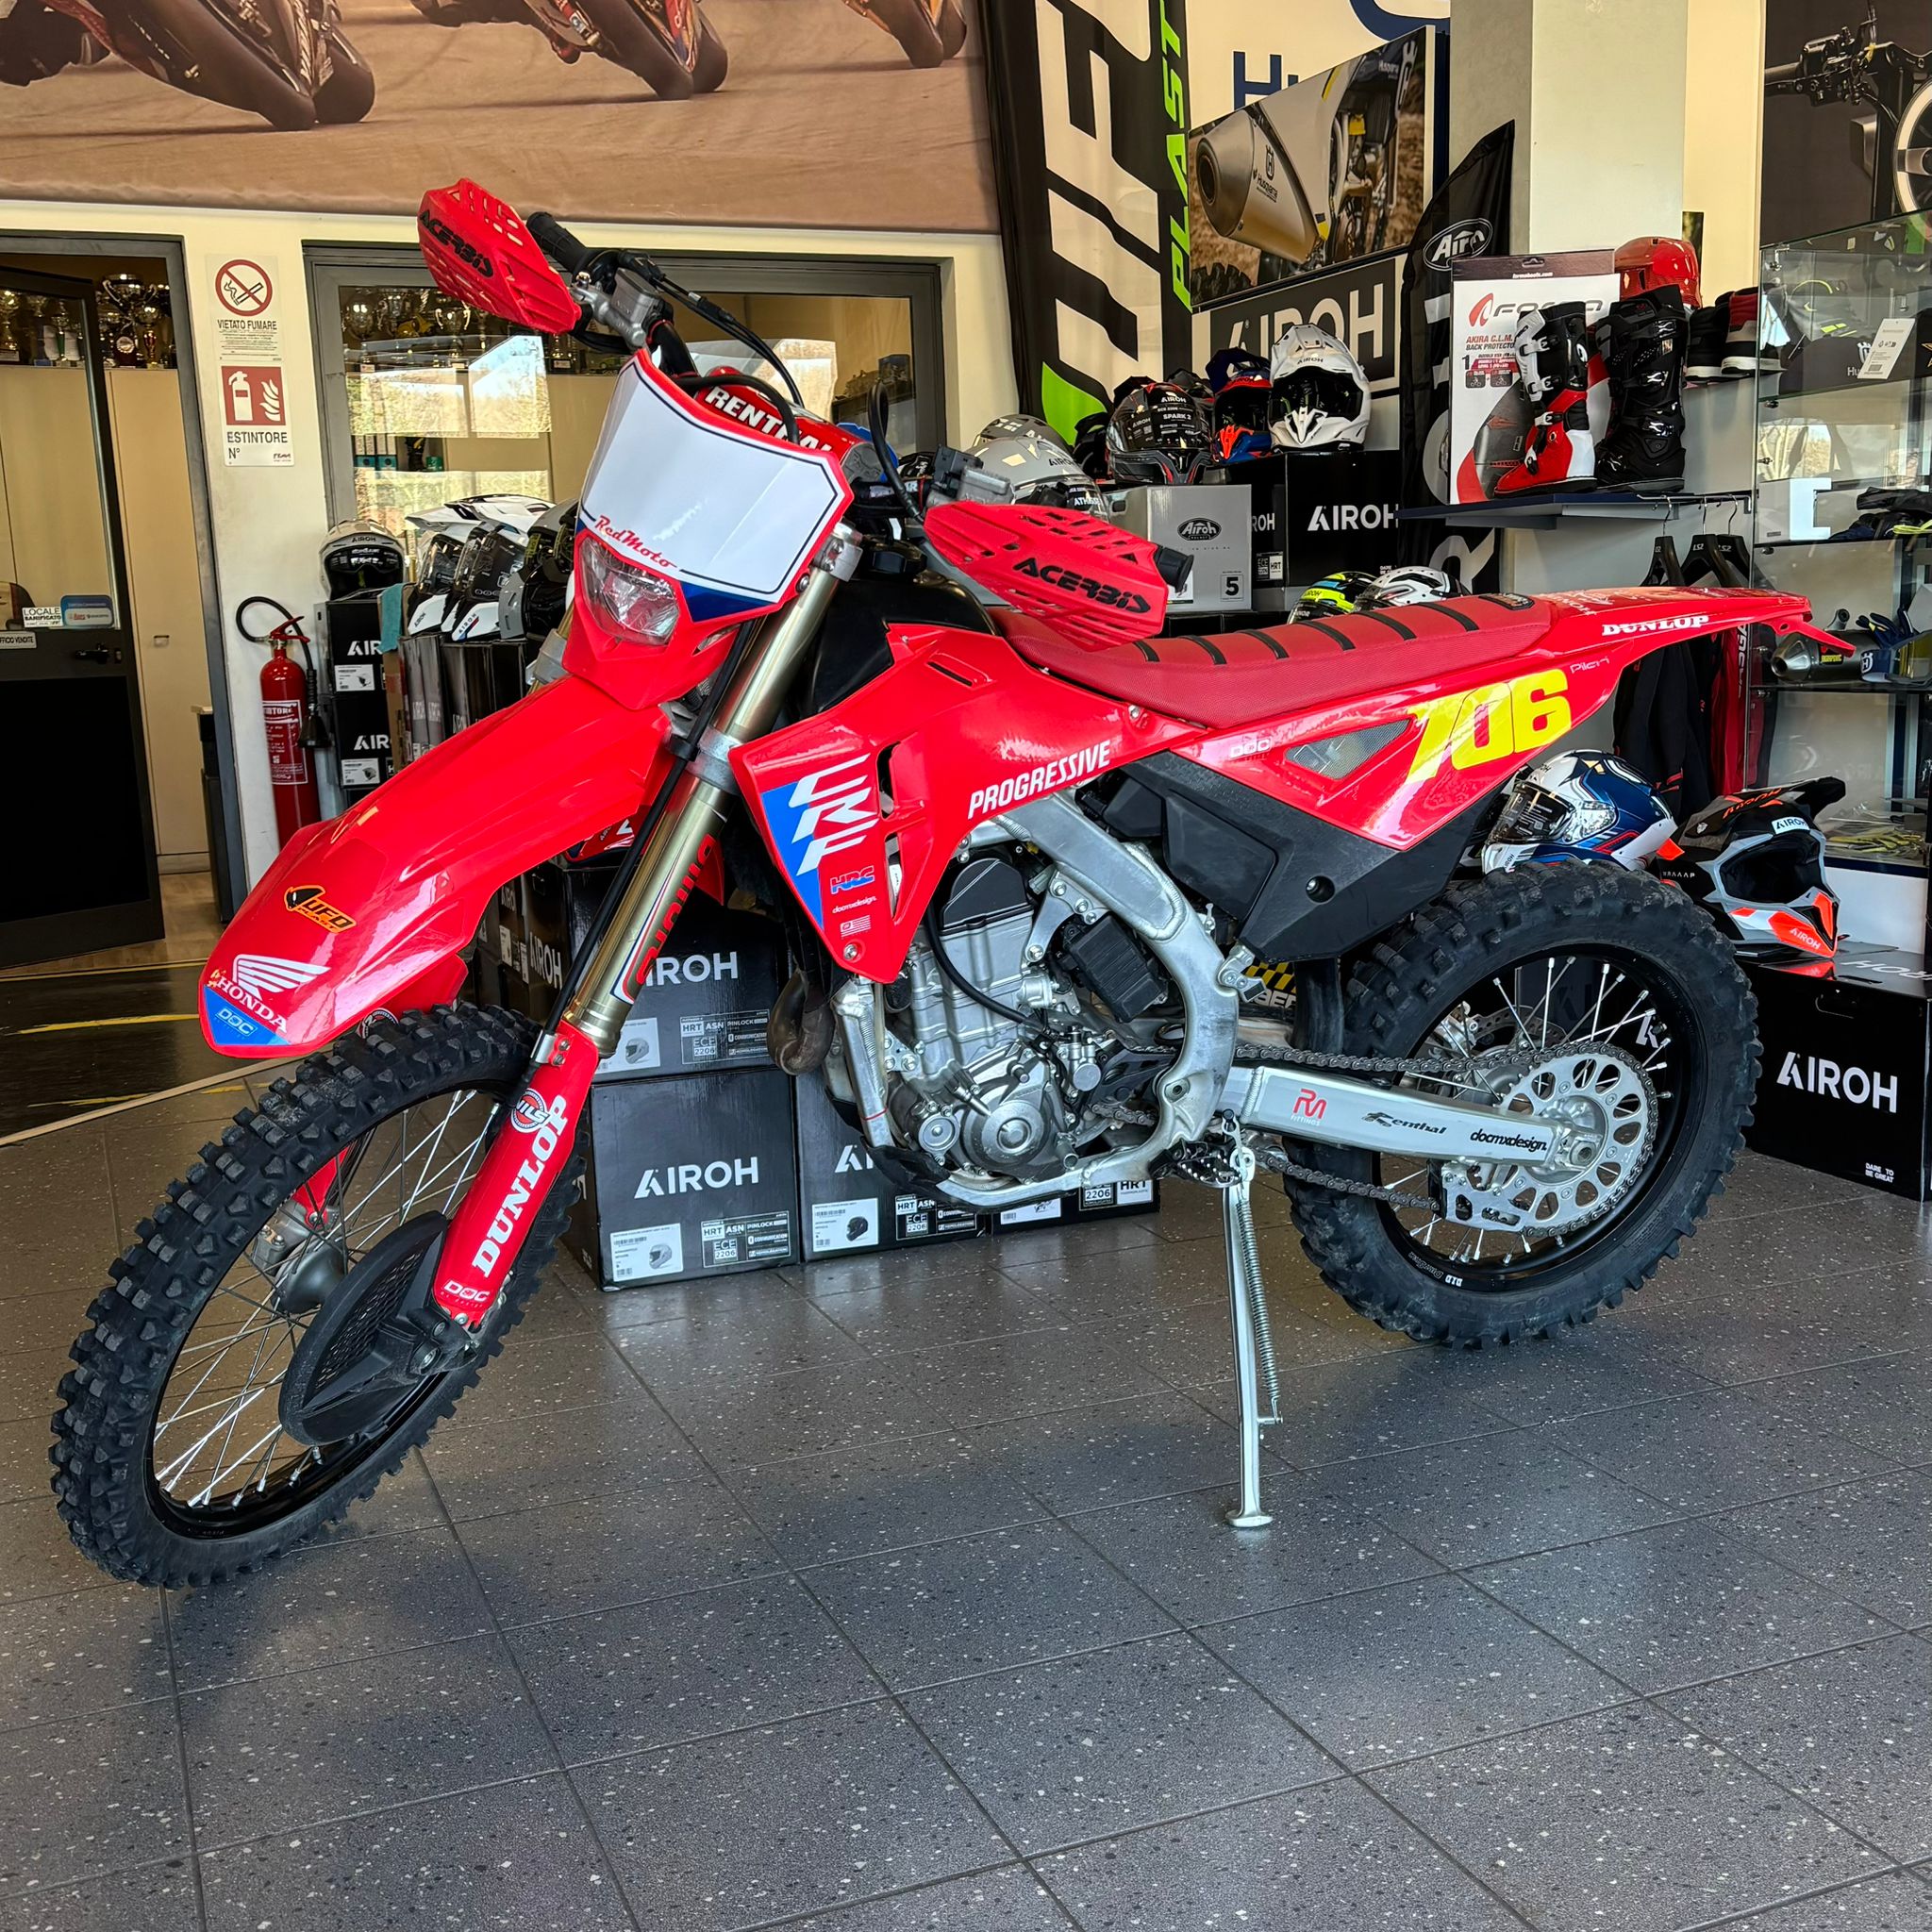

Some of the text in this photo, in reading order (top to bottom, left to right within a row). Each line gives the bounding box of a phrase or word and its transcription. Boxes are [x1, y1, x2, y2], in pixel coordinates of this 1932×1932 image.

[419, 209, 494, 278] ACERBIS
[217, 319, 277, 330] VIETATO FUMARE
[226, 431, 289, 443] ESTINTORE
[1252, 513, 1275, 532] ROH
[1307, 504, 1399, 531] AIROH
[1182, 520, 1218, 535] Airoh
[594, 515, 677, 569] RedMoto
[1012, 557, 1151, 613] ACERBIS
[1224, 576, 1240, 595] 5
[24, 608, 60, 616] LOCALE
[1602, 615, 1709, 636] DUNLOP
[347, 640, 383, 657] AIR
[1404, 668, 1573, 785] 706
[354, 735, 392, 751] AIR
[967, 740, 1111, 820] PROGRESSIVE
[788, 753, 880, 876] CRF
[830, 865, 875, 895] HRC
[501, 885, 516, 912] AIRO
[301, 899, 354, 929] UFO
[1790, 927, 1823, 950] AIROH
[529, 930, 563, 991] AIROH
[645, 951, 739, 987] IROH
[216, 977, 287, 1034] HONDA
[682, 1022, 724, 1032] HRT ASN
[726, 1019, 755, 1027] PINLOCK
[693, 1037, 716, 1047] ECE
[694, 1047, 716, 1056] 2206
[1777, 1051, 1898, 1113] AIROH
[1291, 1114, 1321, 1127] FITTINGS
[633, 1157, 759, 1199] AIROH
[1865, 1162, 1894, 1177] DARE TO
[1865, 1169, 1894, 1183] BE GREAT
[472, 1094, 569, 1278] DUNLOP
[1086, 1189, 1111, 1200] 2206
[917, 1199, 935, 1208] ASN
[746, 1222, 774, 1231] PINLOCK
[906, 1213, 927, 1224] ECE
[704, 1224, 744, 1237] HRT ASN
[714, 1239, 737, 1250] ECE
[715, 1250, 736, 1258] 2206
[443, 1279, 490, 1302] DOC
